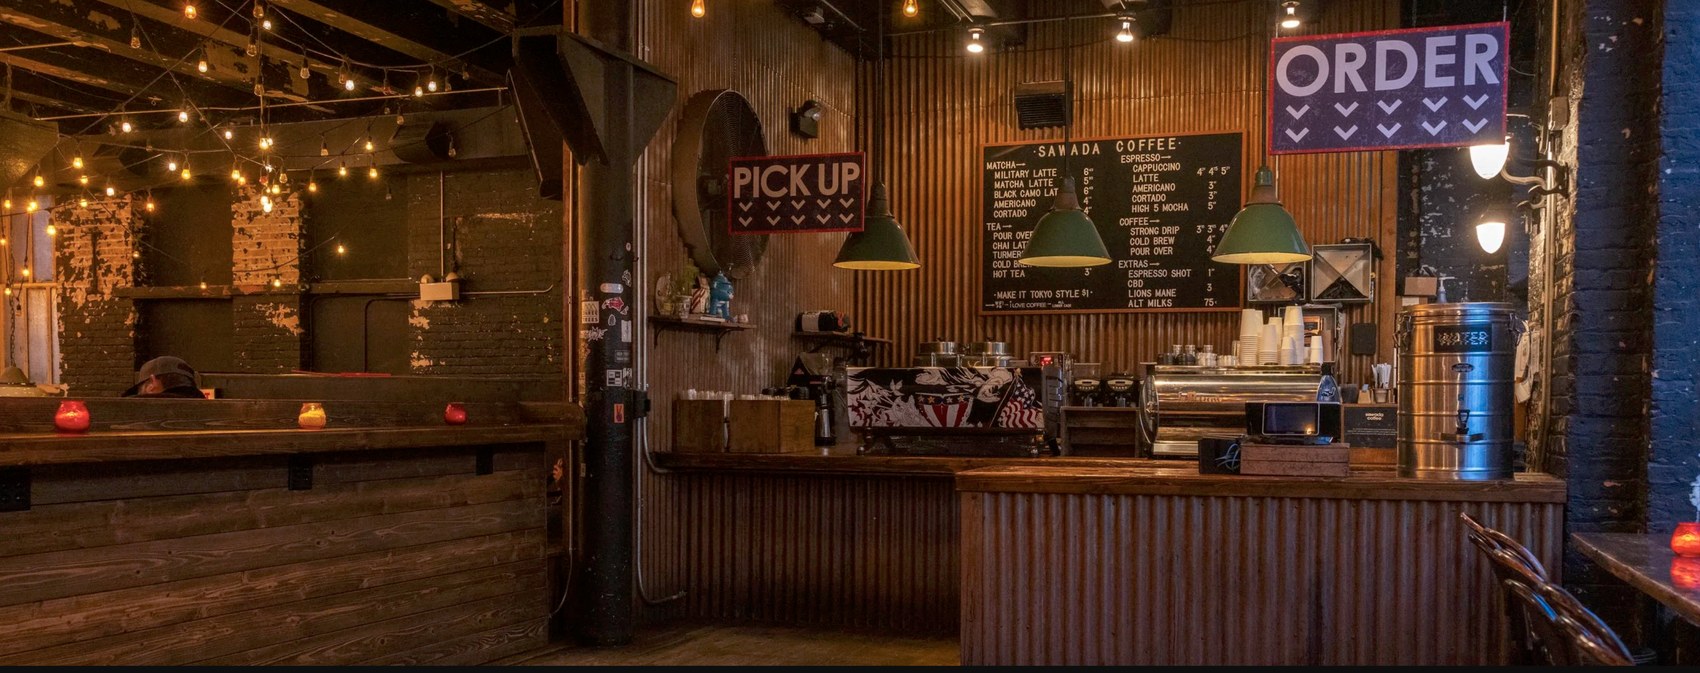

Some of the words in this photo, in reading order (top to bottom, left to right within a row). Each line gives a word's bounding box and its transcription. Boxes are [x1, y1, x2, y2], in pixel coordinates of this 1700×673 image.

[1276, 34, 1499, 97] ORDER
[1039, 143, 1100, 157] SAWADA
[1116, 138, 1176, 152] COFFEE
[1121, 154, 1160, 163] ESPRESSO
[1133, 163, 1180, 172] CAPPUCCINO
[995, 170, 1029, 179] MILITARY
[1034, 169, 1057, 177] LATTE
[1133, 174, 1159, 182] LATTE
[734, 164, 811, 198] PICK
[818, 162, 860, 195] UP
[994, 180, 1024, 188] MATCHA
[1029, 179, 1053, 187] LATTE
[1132, 183, 1175, 192] AMERICANO
[994, 190, 1016, 198] BLACK
[1020, 189, 1040, 197] CAMO
[1132, 194, 1166, 202] CORTADO
[994, 200, 1036, 208] AMERICANO
[1132, 205, 1149, 213] HIGH
[1154, 204, 1159, 212] 5
[1162, 203, 1188, 212] MOCHA
[994, 210, 1027, 218] CORTADO
[1120, 217, 1148, 226] COFFEE
[1130, 227, 1159, 236] STRONG
[1162, 226, 1180, 234] DRIP
[994, 232, 1012, 240] POUR
[1154, 237, 1175, 245] BREW
[993, 242, 1010, 250] CHAI
[1130, 248, 1150, 256] POUR
[1154, 247, 1173, 255] OVER
[1118, 260, 1148, 268] EXTRAS
[993, 270, 1007, 278] HOT
[1011, 270, 1025, 278] TEA
[1129, 270, 1167, 278] ESPRESSO
[1171, 269, 1191, 277] SHOT
[1207, 283, 1212, 292] 3
[997, 291, 1016, 299] MAKE
[1019, 290, 1026, 298] IT
[1030, 290, 1052, 298] TOKYO
[1056, 290, 1079, 298] STYLE
[1082, 289, 1089, 297] $1
[1129, 290, 1151, 298] LIONS
[1155, 289, 1176, 297] MANE
[1148, 299, 1172, 307] MILKS
[1438, 332, 1488, 346] WATER
